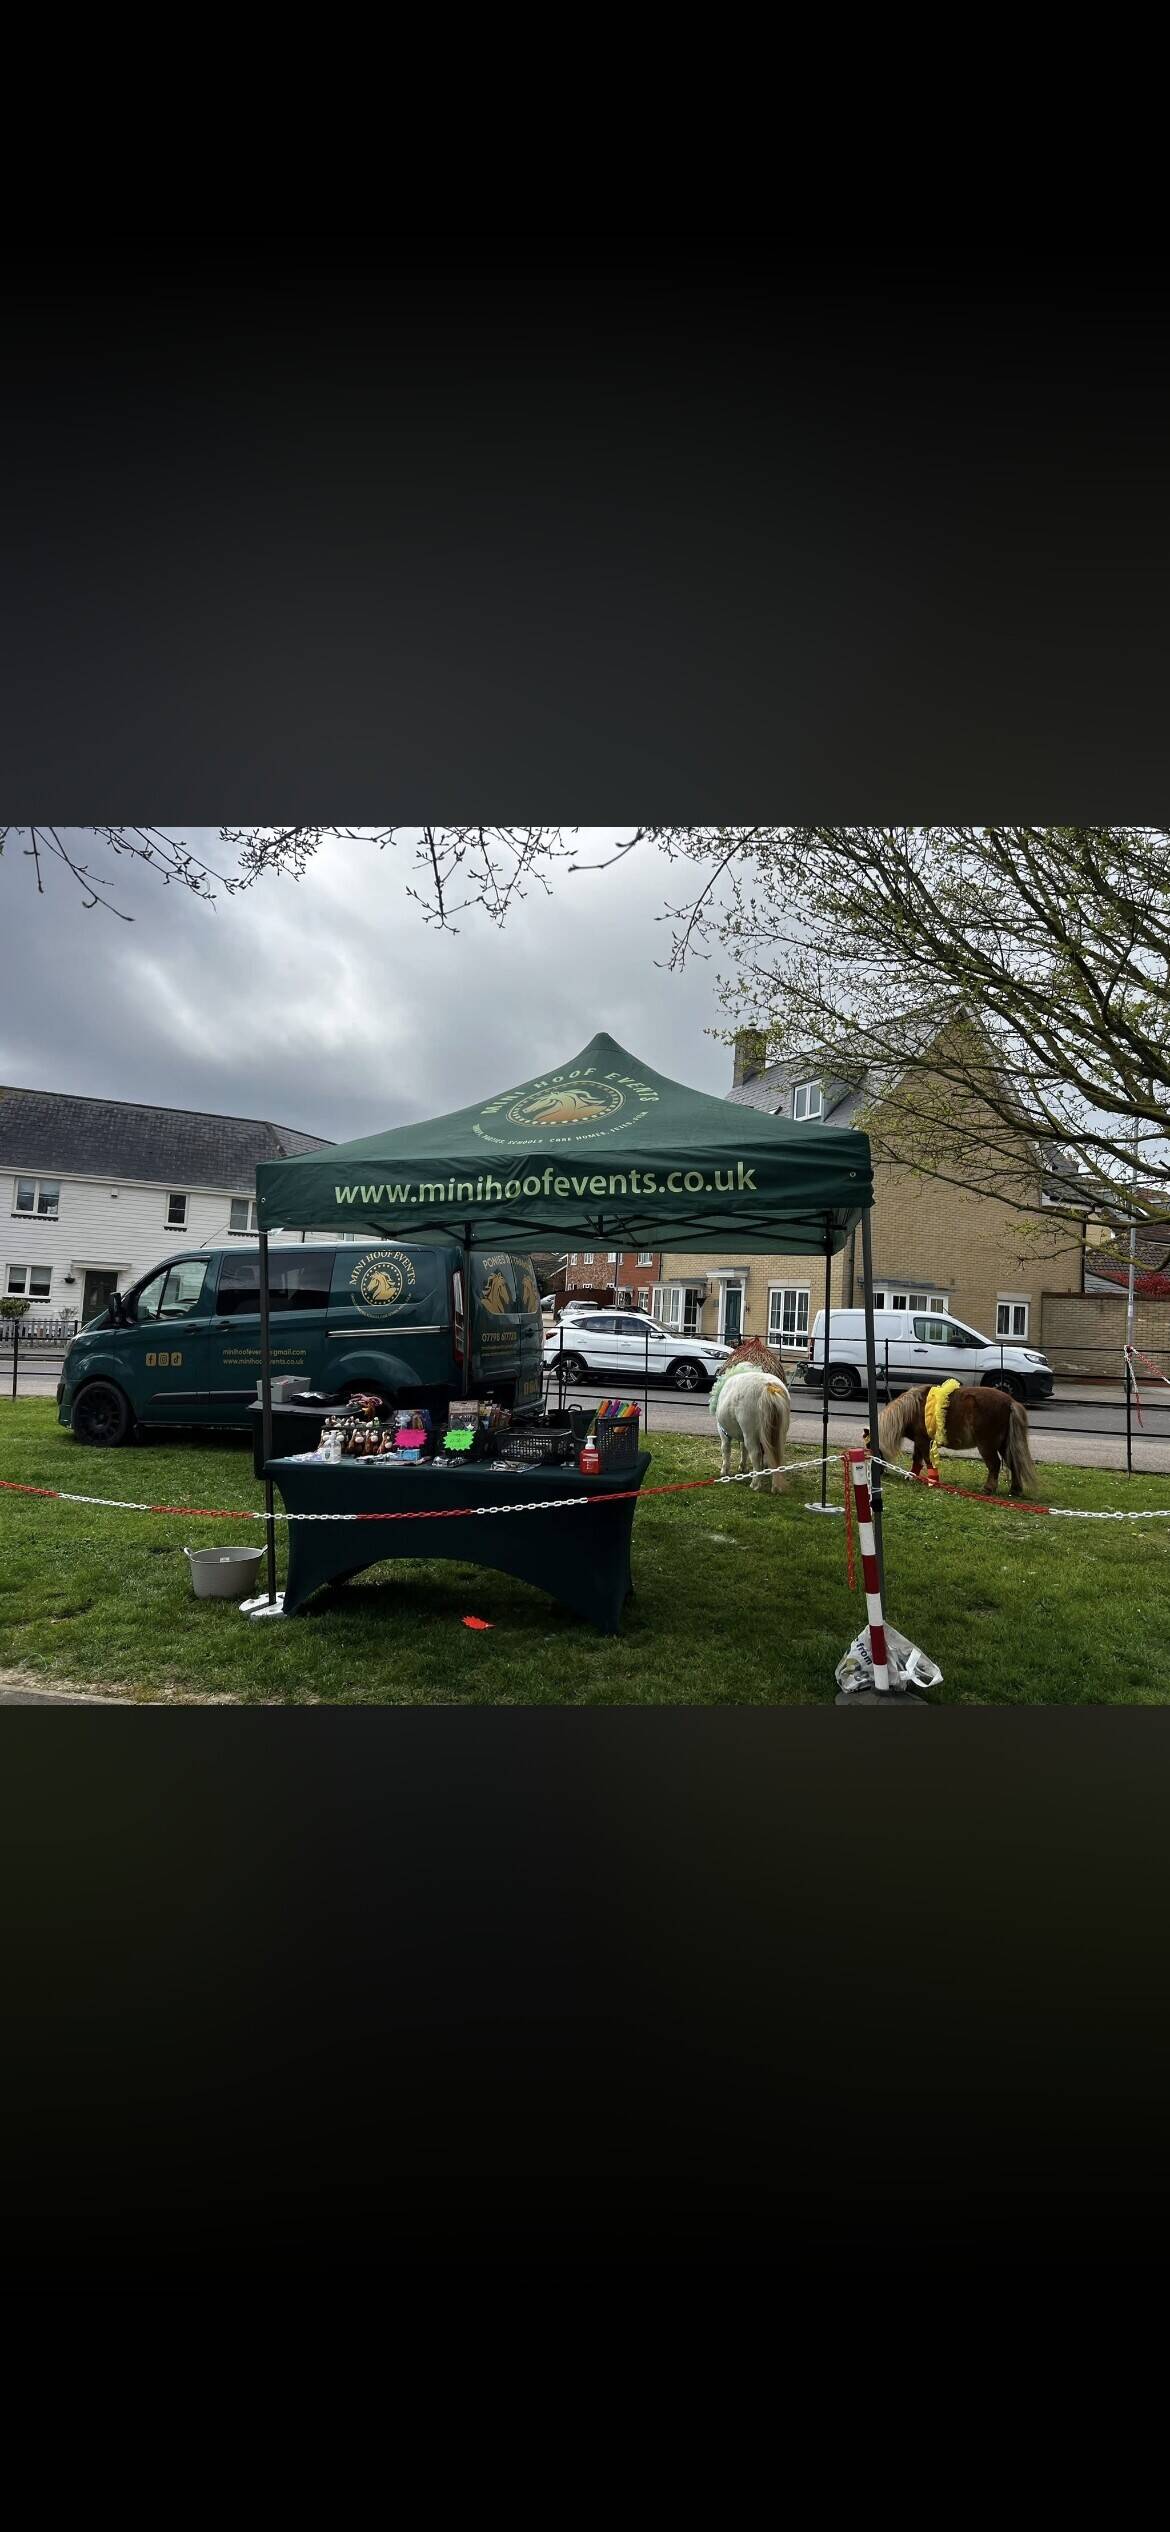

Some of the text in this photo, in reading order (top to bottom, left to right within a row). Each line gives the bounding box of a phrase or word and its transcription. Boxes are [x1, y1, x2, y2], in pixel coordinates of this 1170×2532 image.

[480, 1067, 660, 1115] MINI HOOF EVENTS
[335, 1162, 757, 1204] www.minihoofevents.co.uk
[349, 1249, 416, 1285] MINI HOOF EVENTS
[856, 1642, 872, 1665] from
